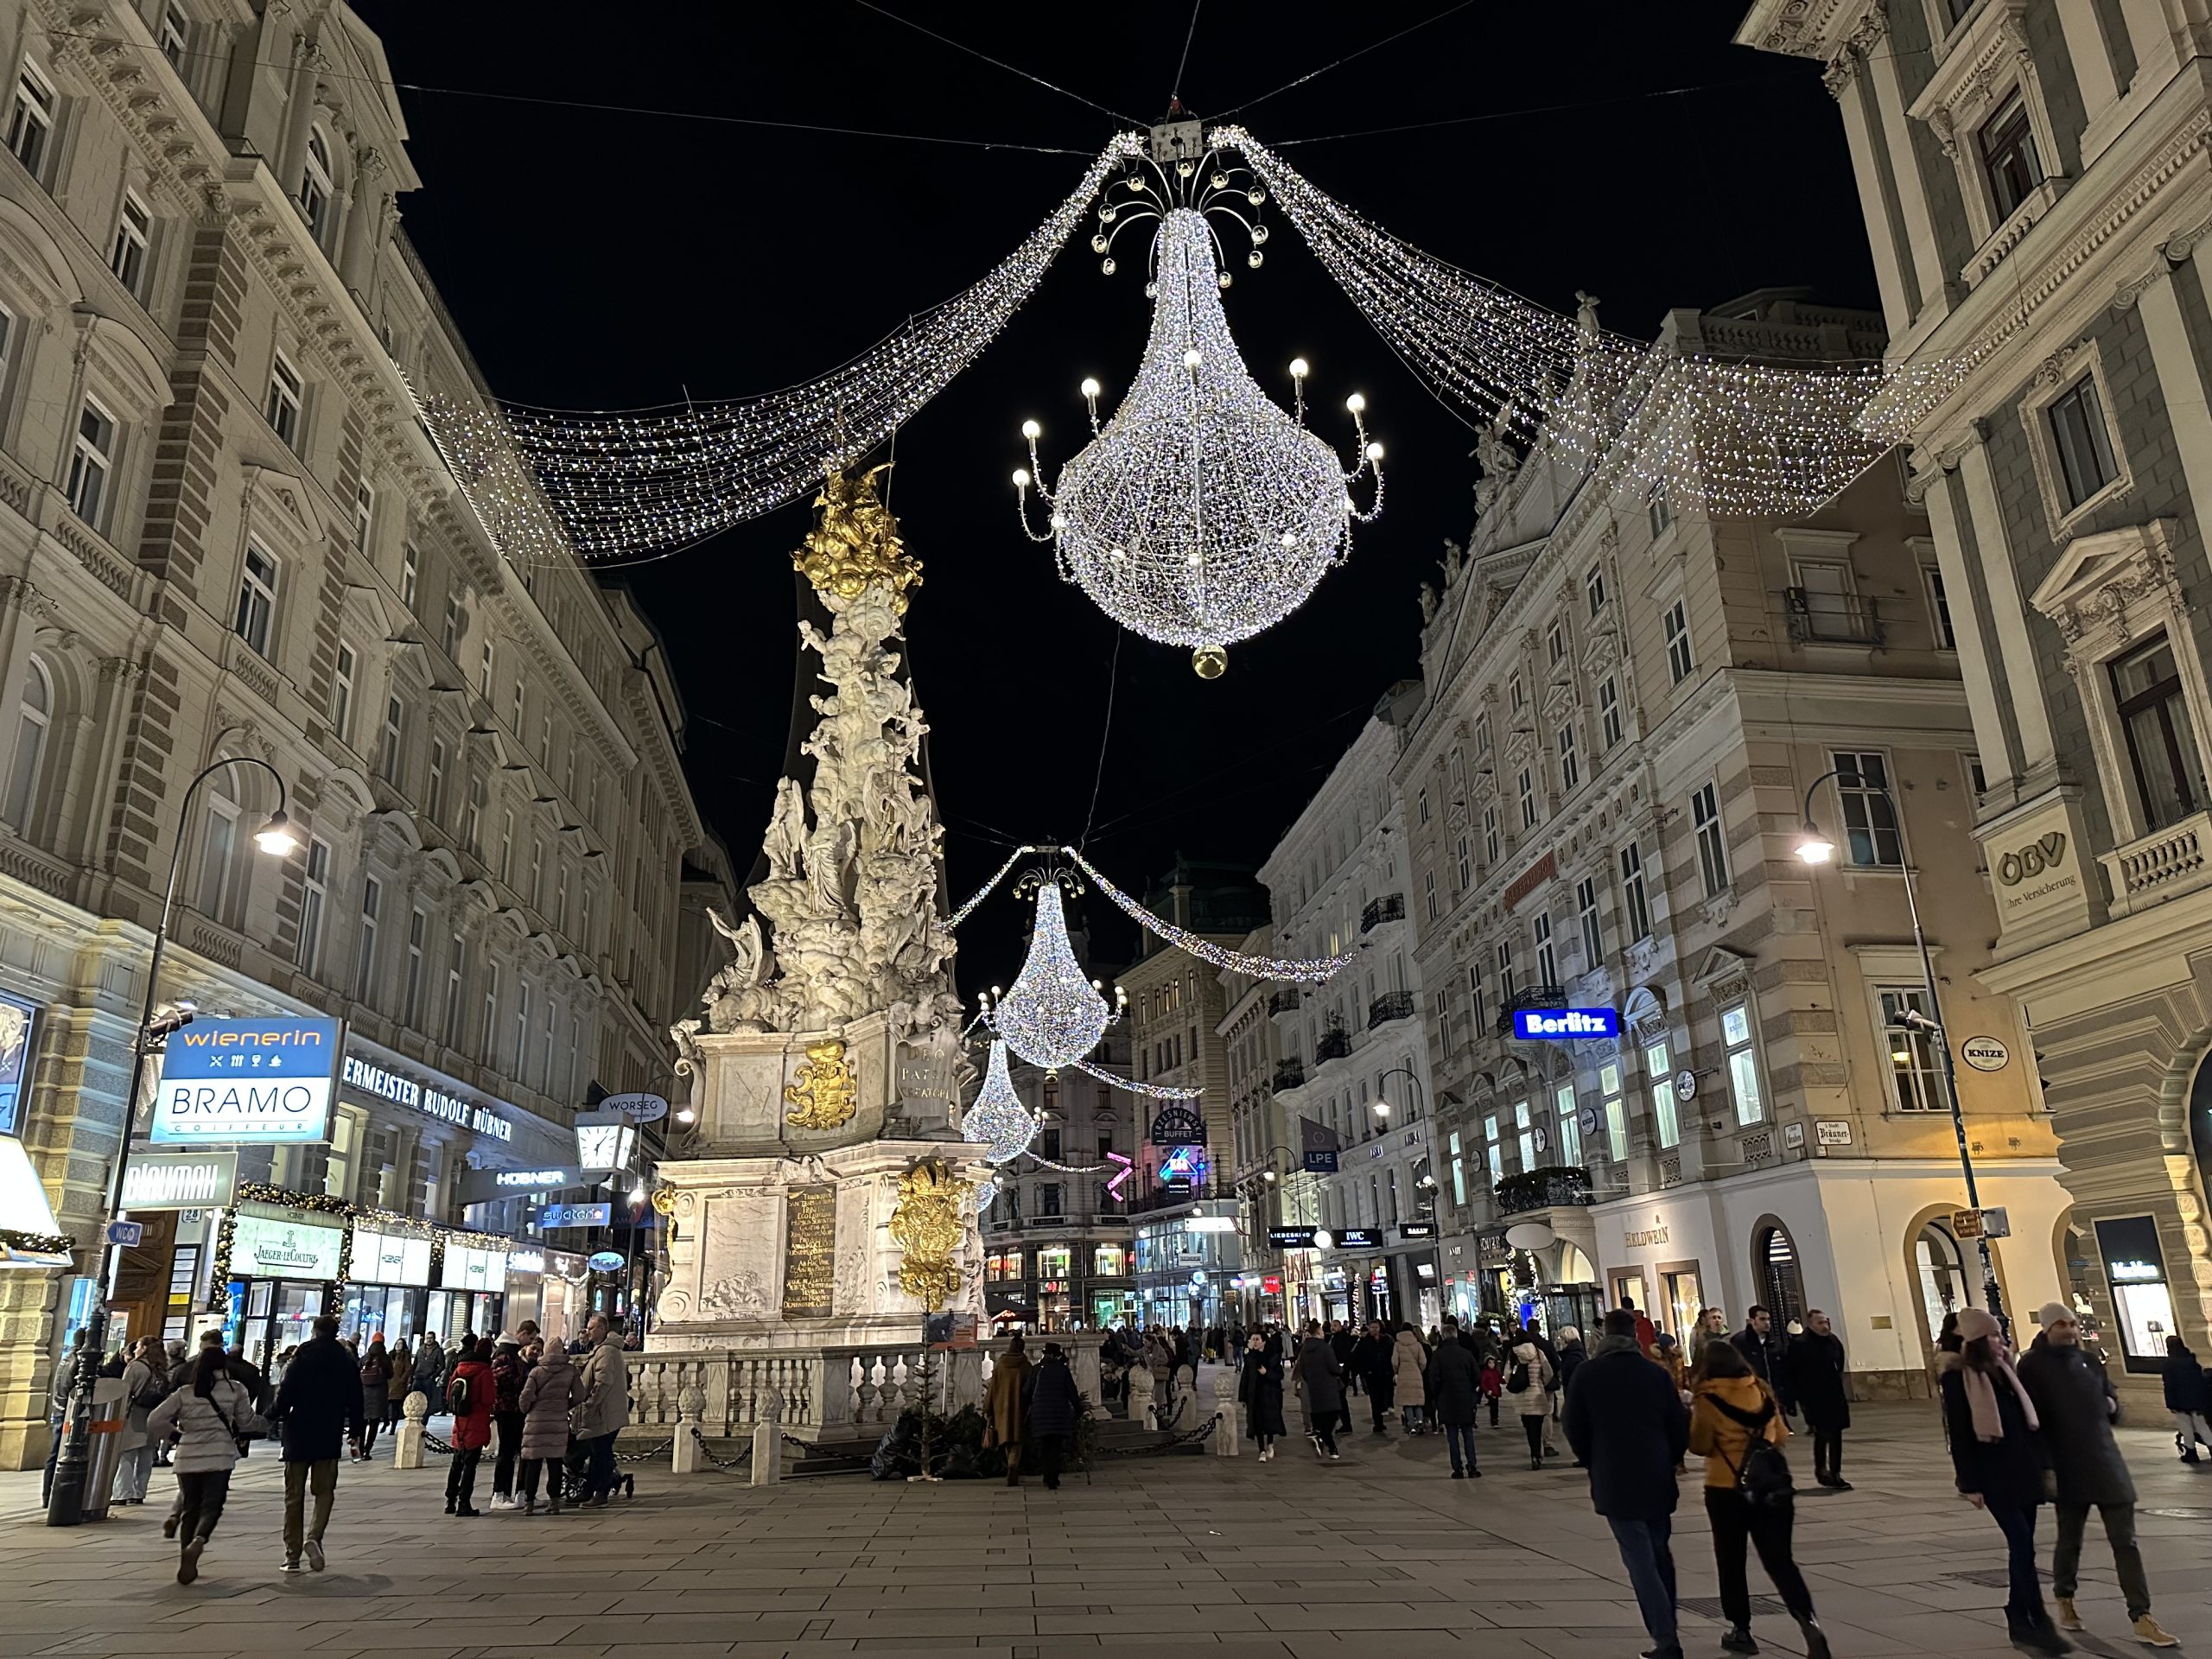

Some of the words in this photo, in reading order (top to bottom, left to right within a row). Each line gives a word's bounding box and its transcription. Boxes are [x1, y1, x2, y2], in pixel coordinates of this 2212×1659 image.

[2022, 874, 2075, 901] Versicherung
[1526, 1012, 1606, 1033] Berlitz
[184, 1030, 321, 1047] wienerin
[1967, 1049, 2005, 1058] KNIZE
[172, 1086, 311, 1115] BRAMO
[609, 1100, 658, 1110] WORSEG
[423, 1088, 470, 1125] RUDOLF
[473, 1107, 512, 1142] HÜBNER
[1155, 1109, 1202, 1135] TRZESNIEWSKI
[175, 1122, 303, 1132] COIFFEUR
[1819, 1127, 1849, 1139] Bräuner-
[1309, 1154, 1332, 1164] LPE
[186, 1209, 199, 1218] 28
[543, 1208, 594, 1222] swatch
[116, 1226, 128, 1240] WC
[1346, 1231, 1364, 1241] IWC
[1624, 1226, 1669, 1248] HELDWEIN
